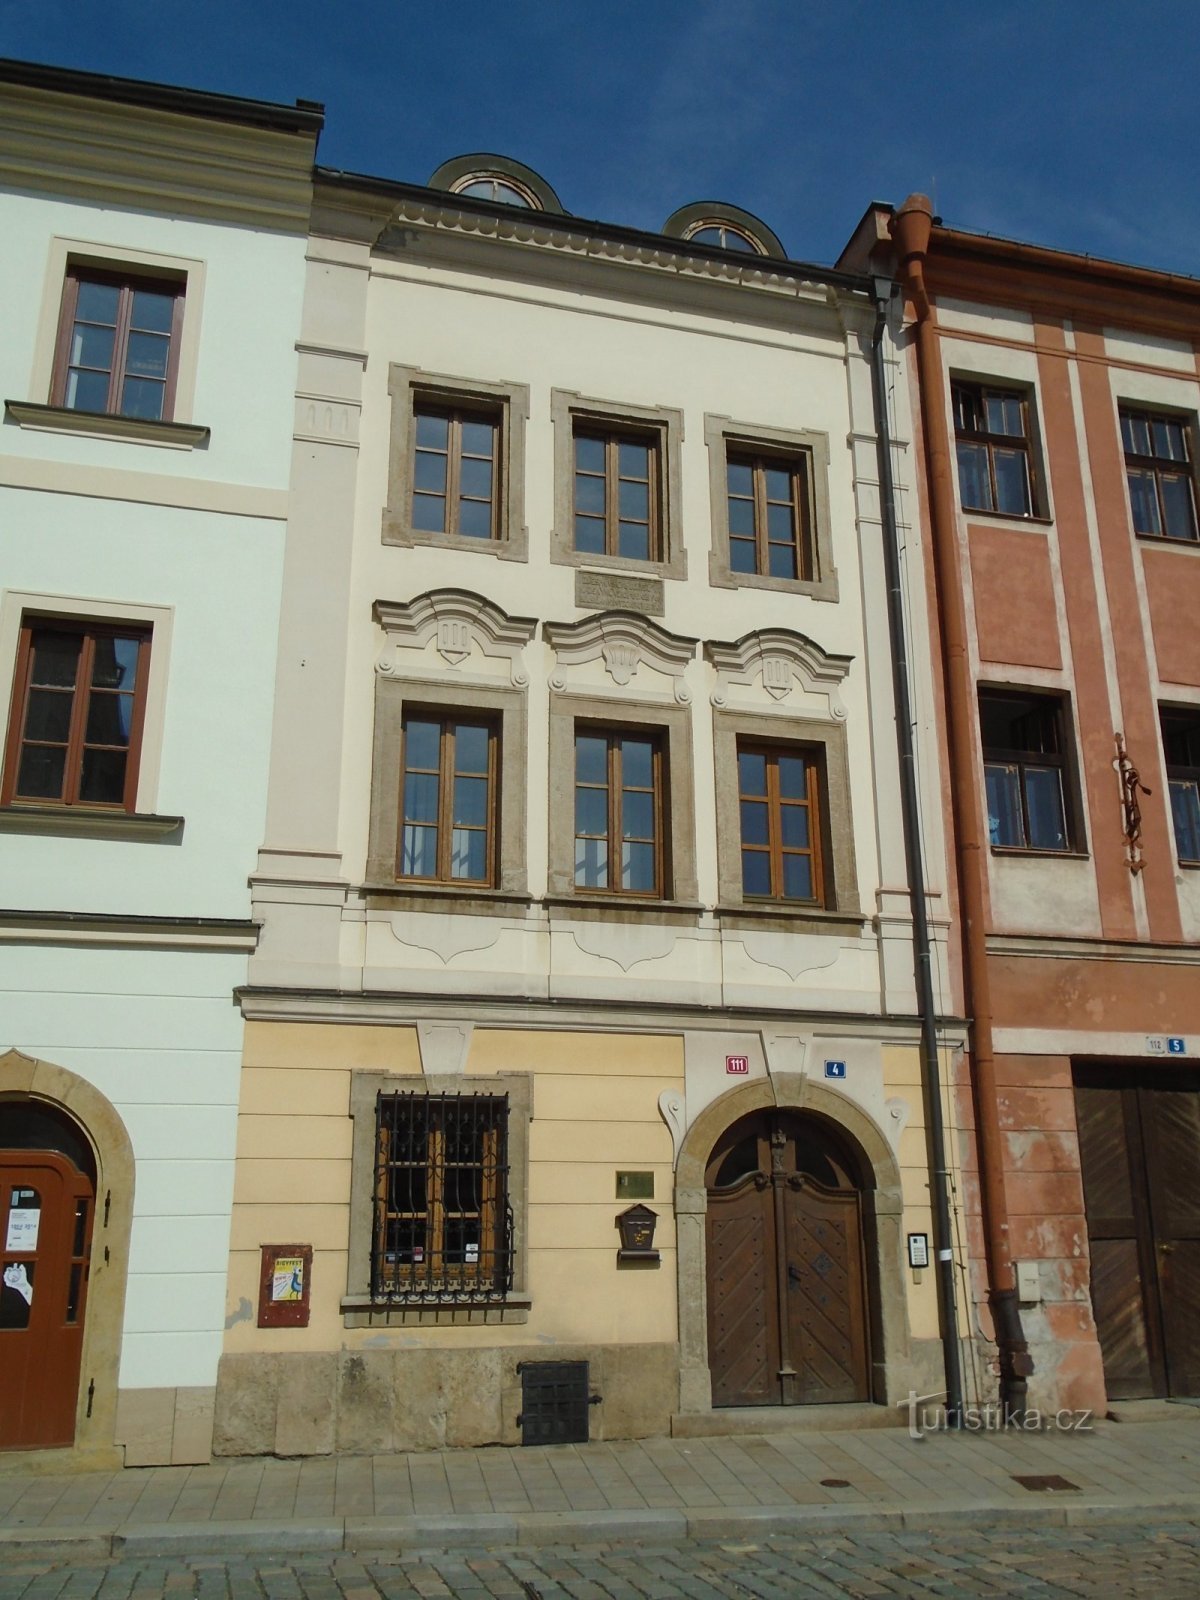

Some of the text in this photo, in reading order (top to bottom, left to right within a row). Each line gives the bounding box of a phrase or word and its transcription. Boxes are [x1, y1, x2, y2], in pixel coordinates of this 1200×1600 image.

[1150, 1040, 1161, 1049] 112
[1173, 1040, 1180, 1051] 5
[731, 1059, 744, 1071] 111
[832, 1063, 839, 1075] 4
